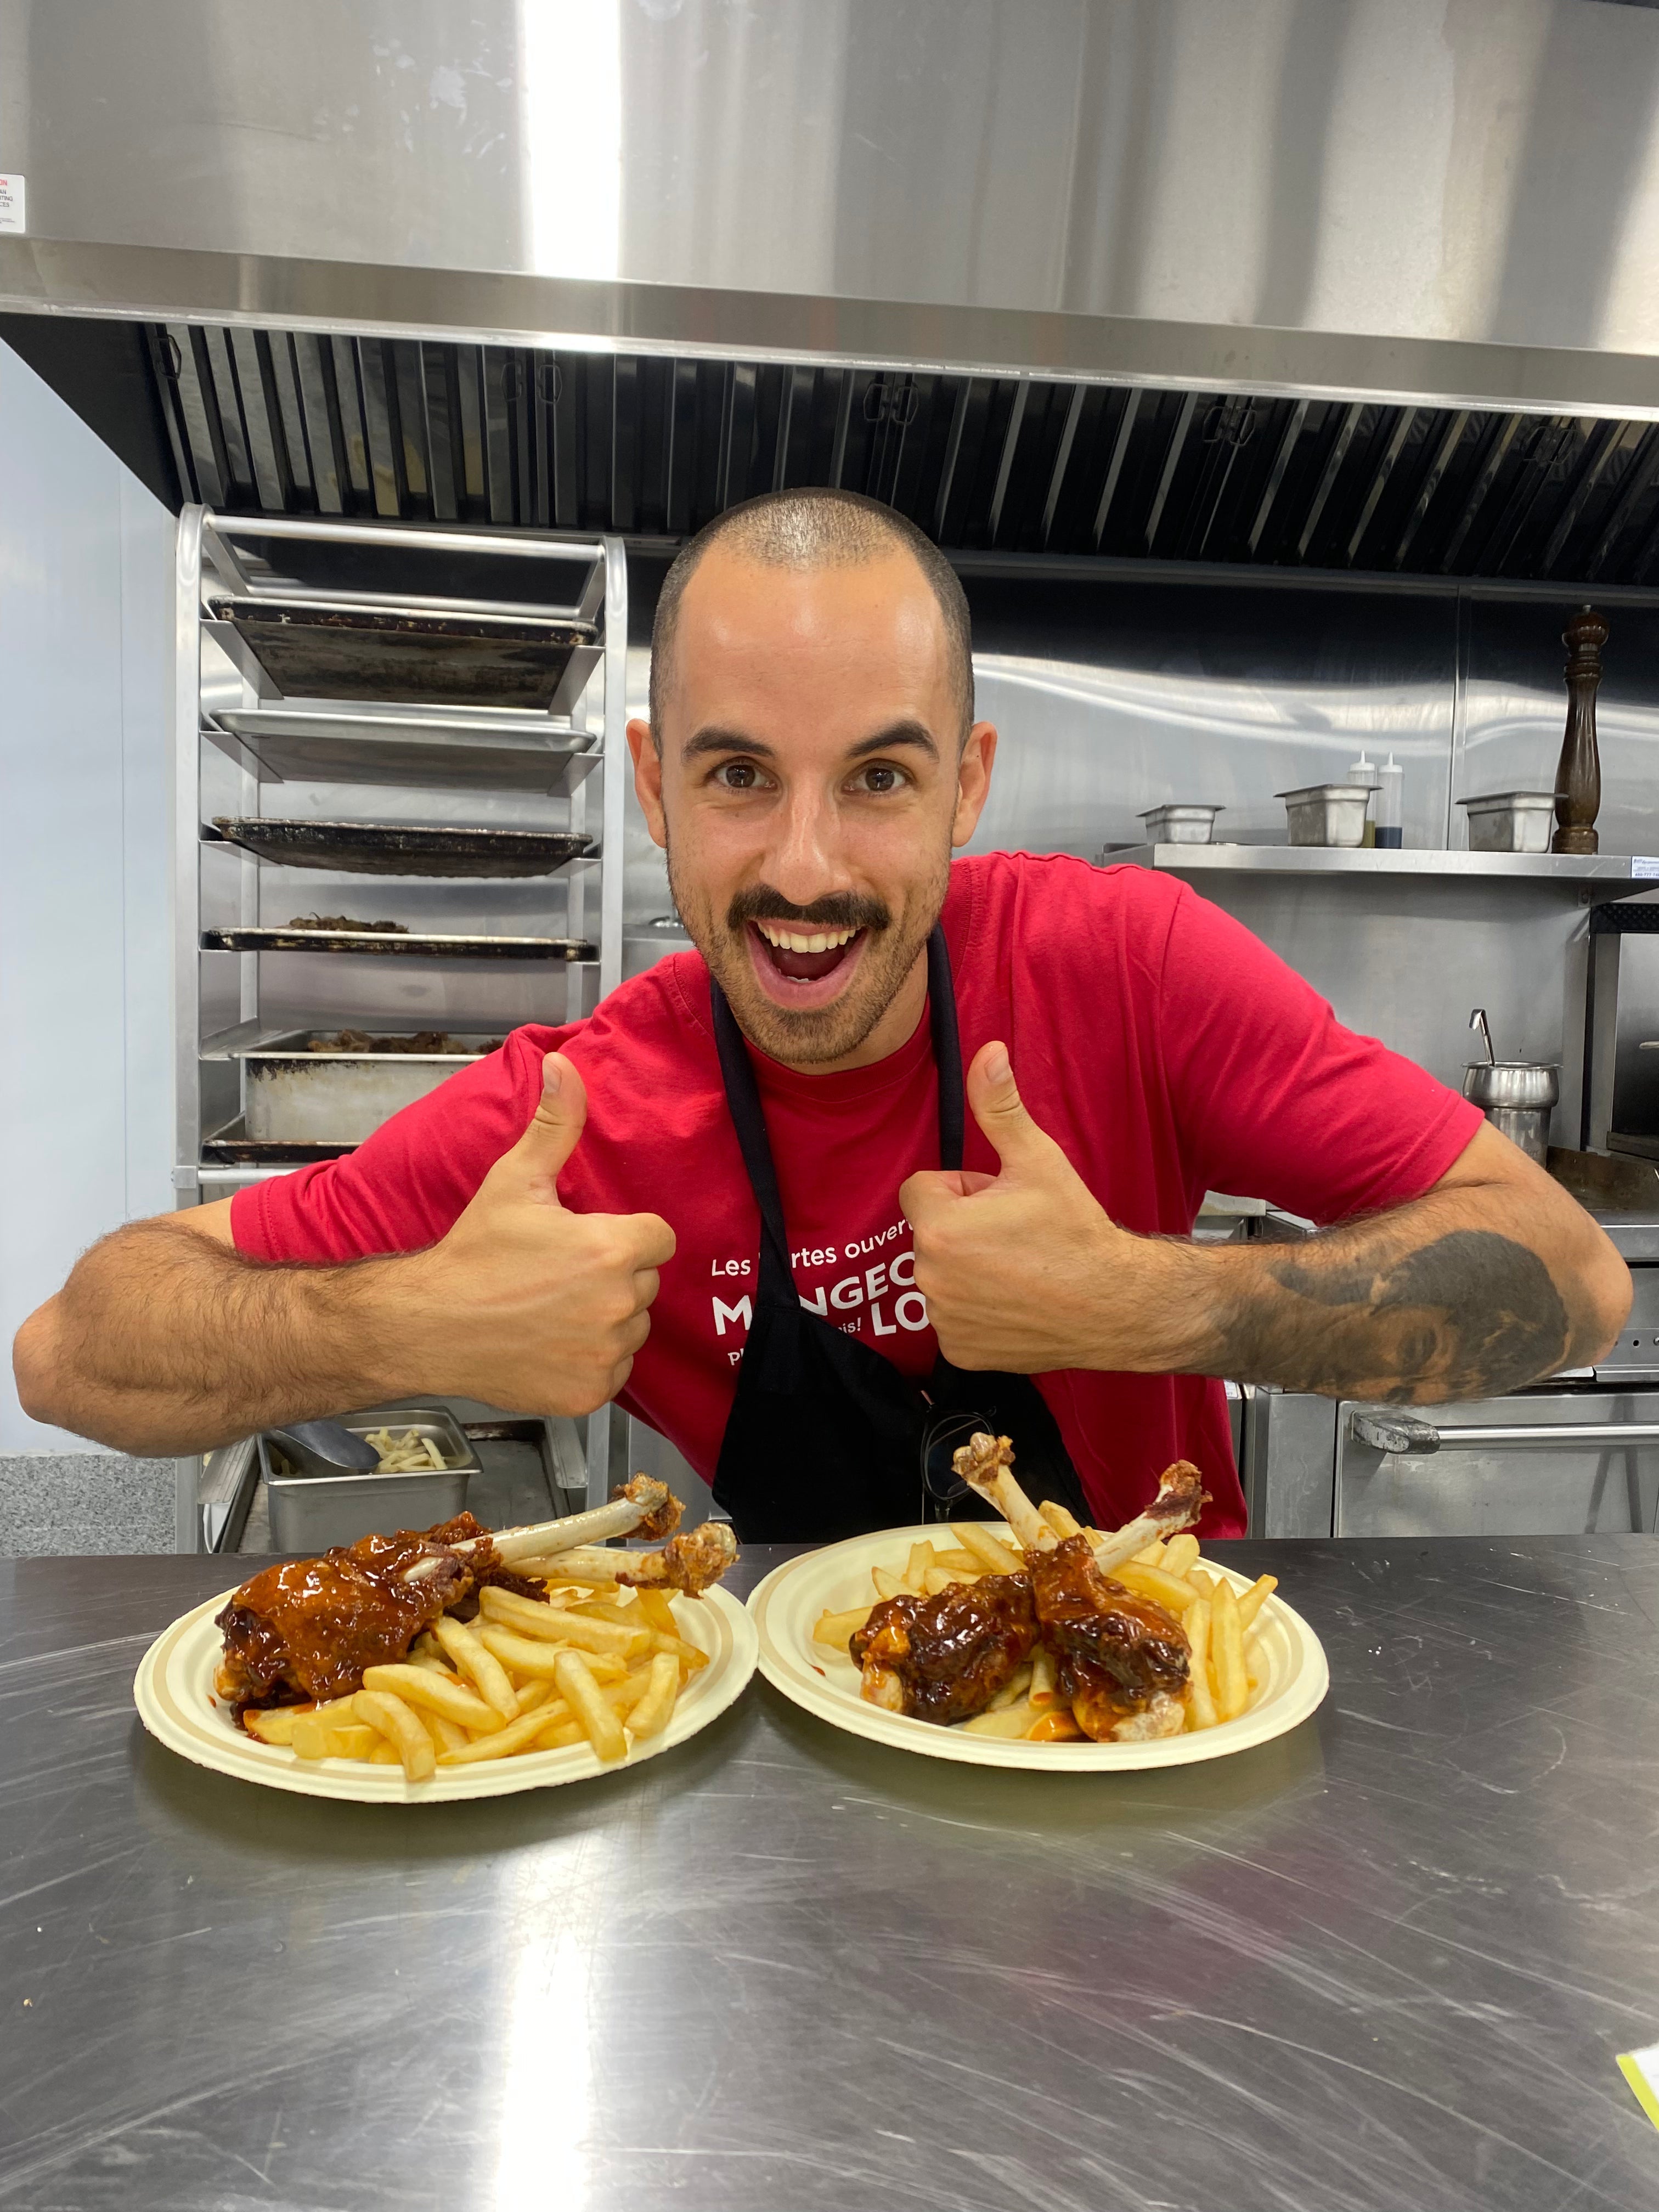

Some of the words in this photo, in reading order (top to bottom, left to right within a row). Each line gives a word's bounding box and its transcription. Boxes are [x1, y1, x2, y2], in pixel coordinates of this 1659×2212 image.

[712, 1259, 751, 1277] Les
[759, 1247, 837, 1268] rtes
[712, 1251, 916, 1336] MNGEO
[838, 1317, 861, 1334] is!
